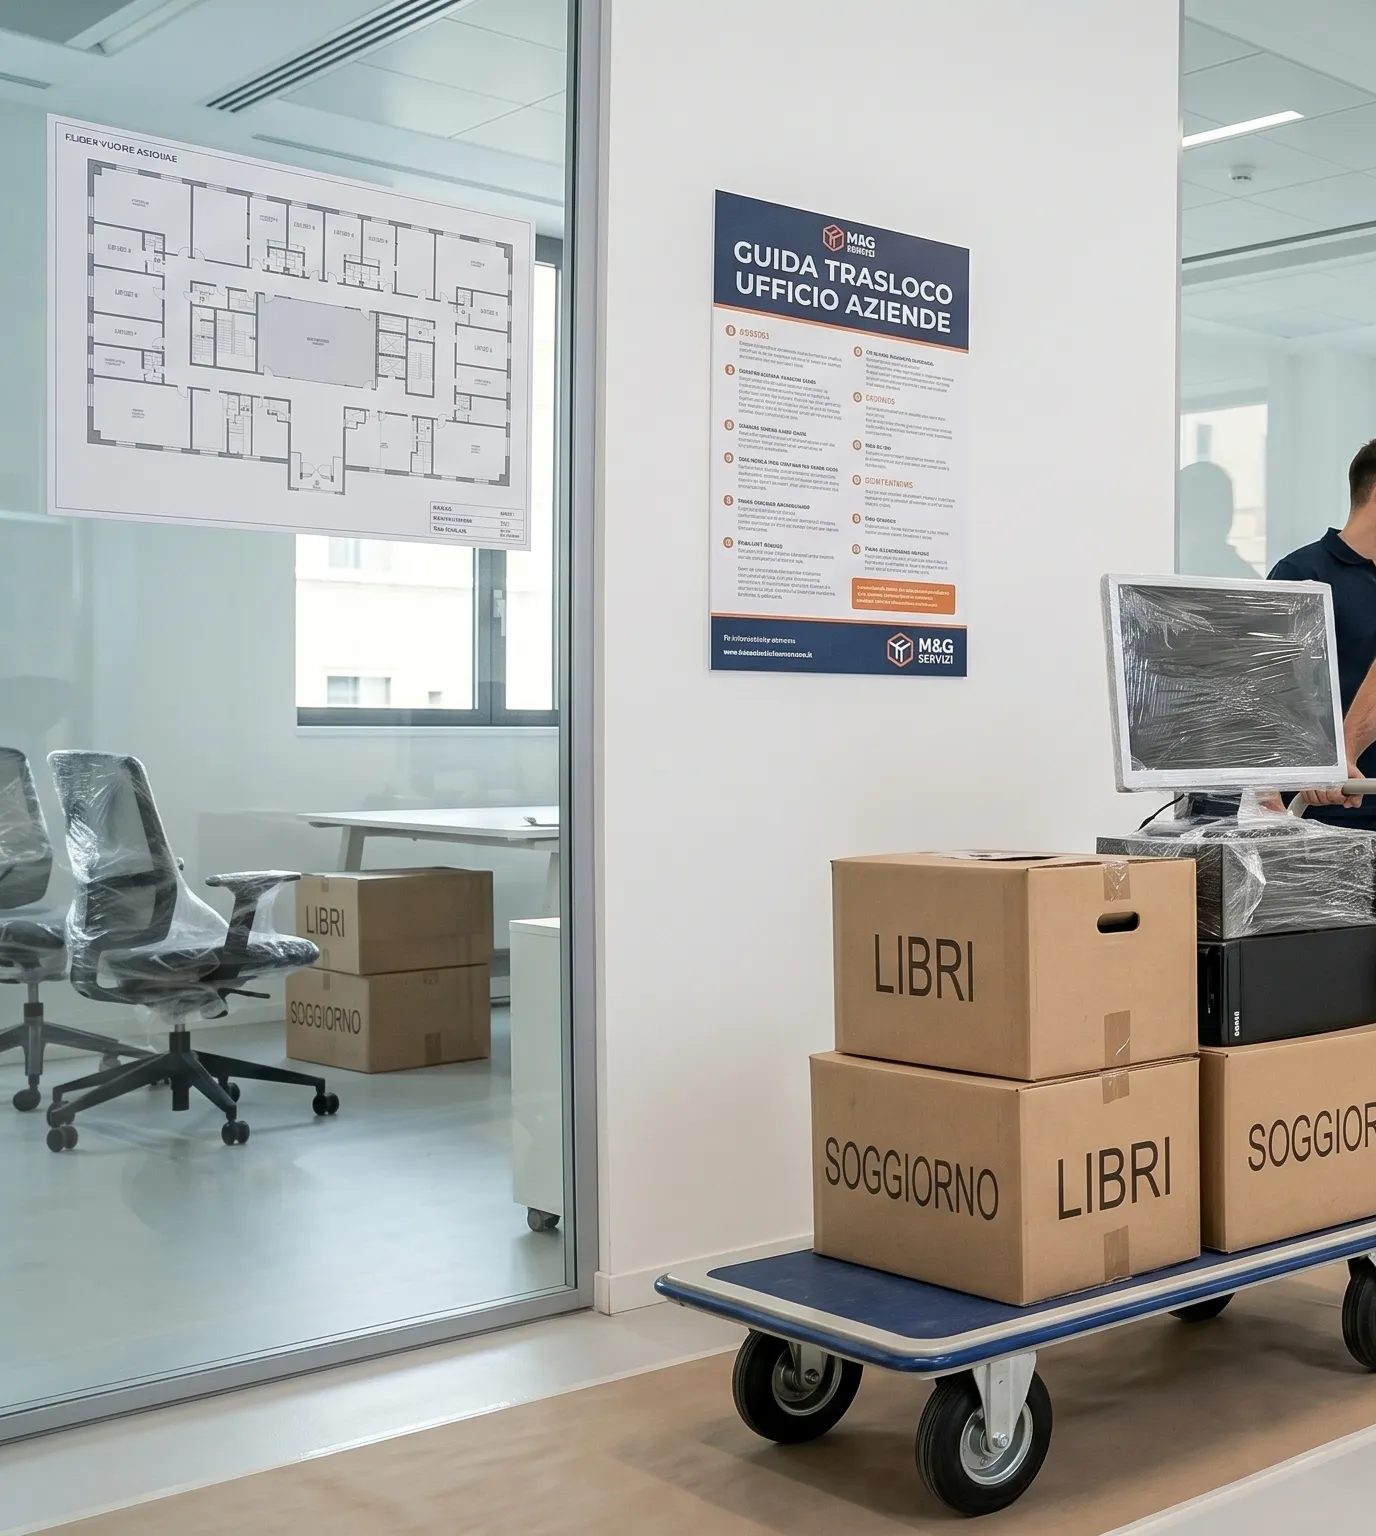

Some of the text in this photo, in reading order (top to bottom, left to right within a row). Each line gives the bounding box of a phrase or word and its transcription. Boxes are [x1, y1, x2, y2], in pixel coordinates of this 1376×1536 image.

[734, 240, 954, 306] GUIDA TRASLOCO
[735, 270, 952, 334] UFFICIO AZIENDE
[918, 637, 954, 654] M&G
[918, 653, 954, 665] SERVIZI
[305, 904, 345, 938] LIBRI
[874, 933, 974, 1003] LIBRI
[290, 1000, 361, 1035] SOGGIORNO
[825, 1136, 999, 1221] SOGGIORNO
[1058, 1136, 1171, 1221] LIBRI
